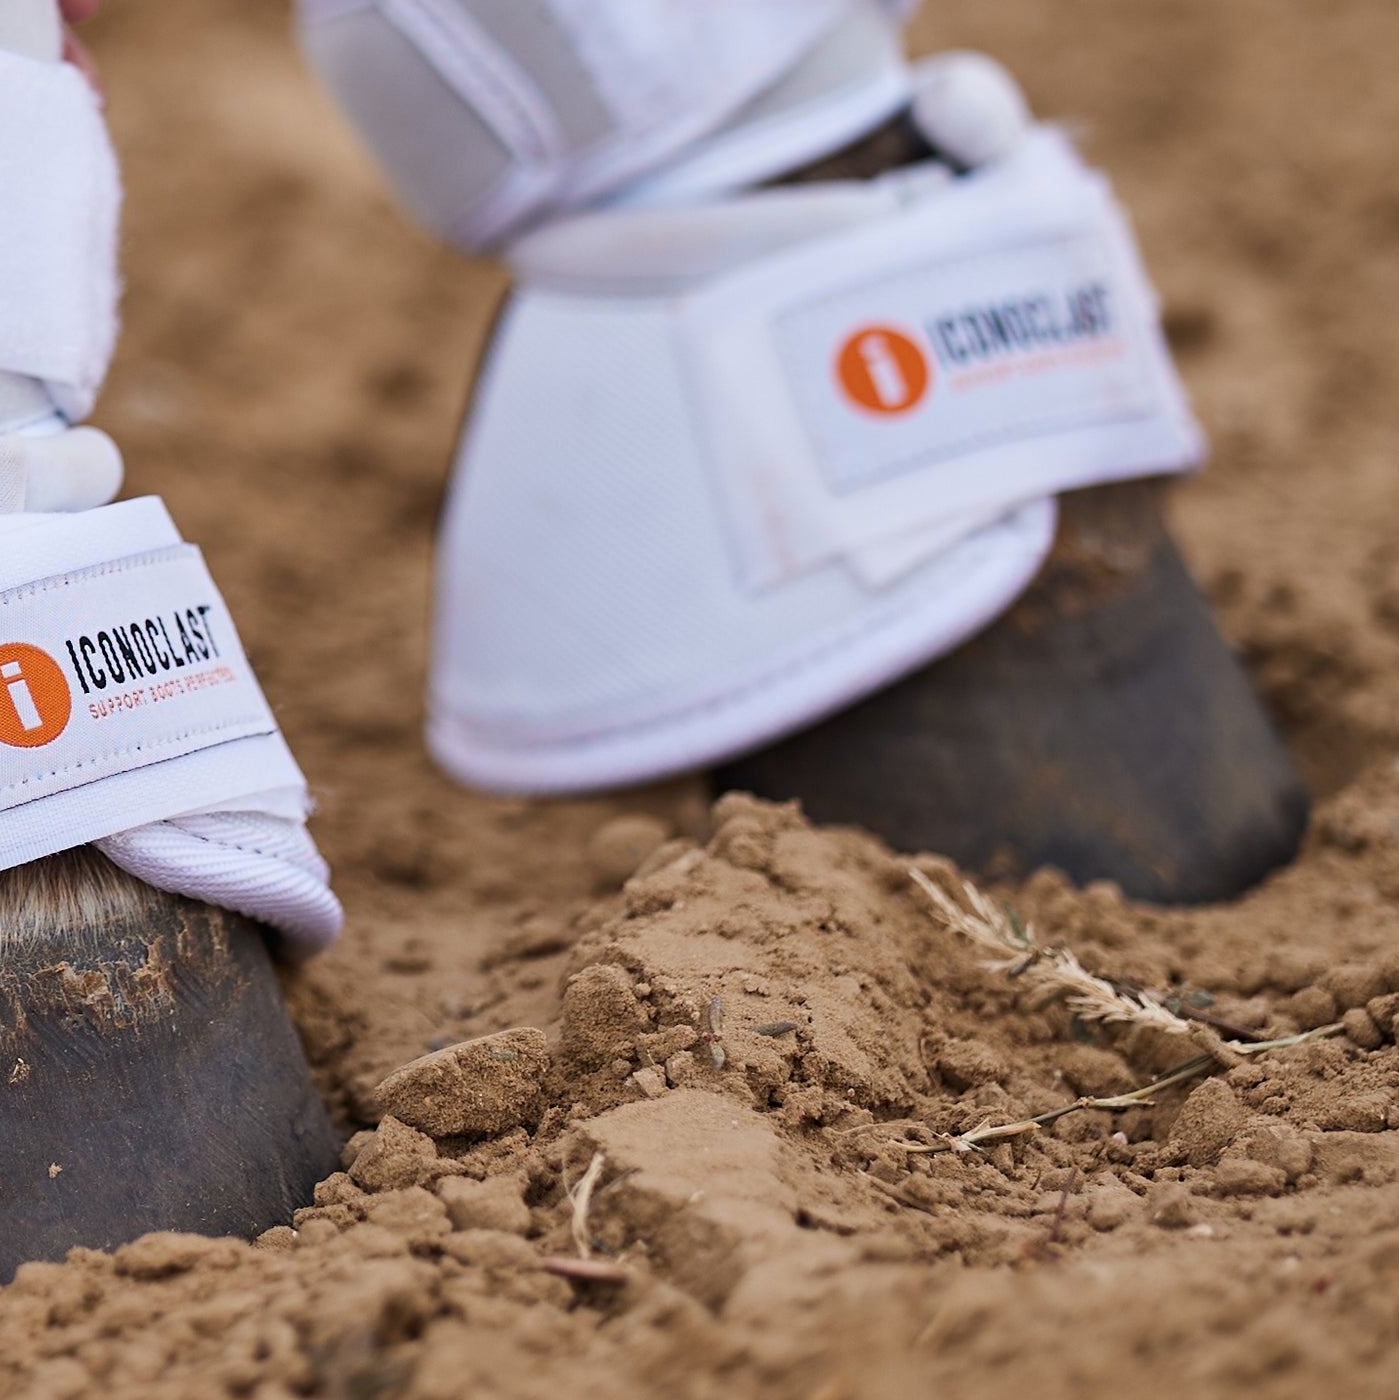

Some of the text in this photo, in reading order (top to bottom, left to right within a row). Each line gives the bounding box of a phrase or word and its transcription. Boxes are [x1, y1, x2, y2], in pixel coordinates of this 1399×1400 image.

[65, 604, 222, 695] ICONOCLAST
[88, 688, 147, 720] SUPPORT
[149, 679, 185, 703] BOOTS
